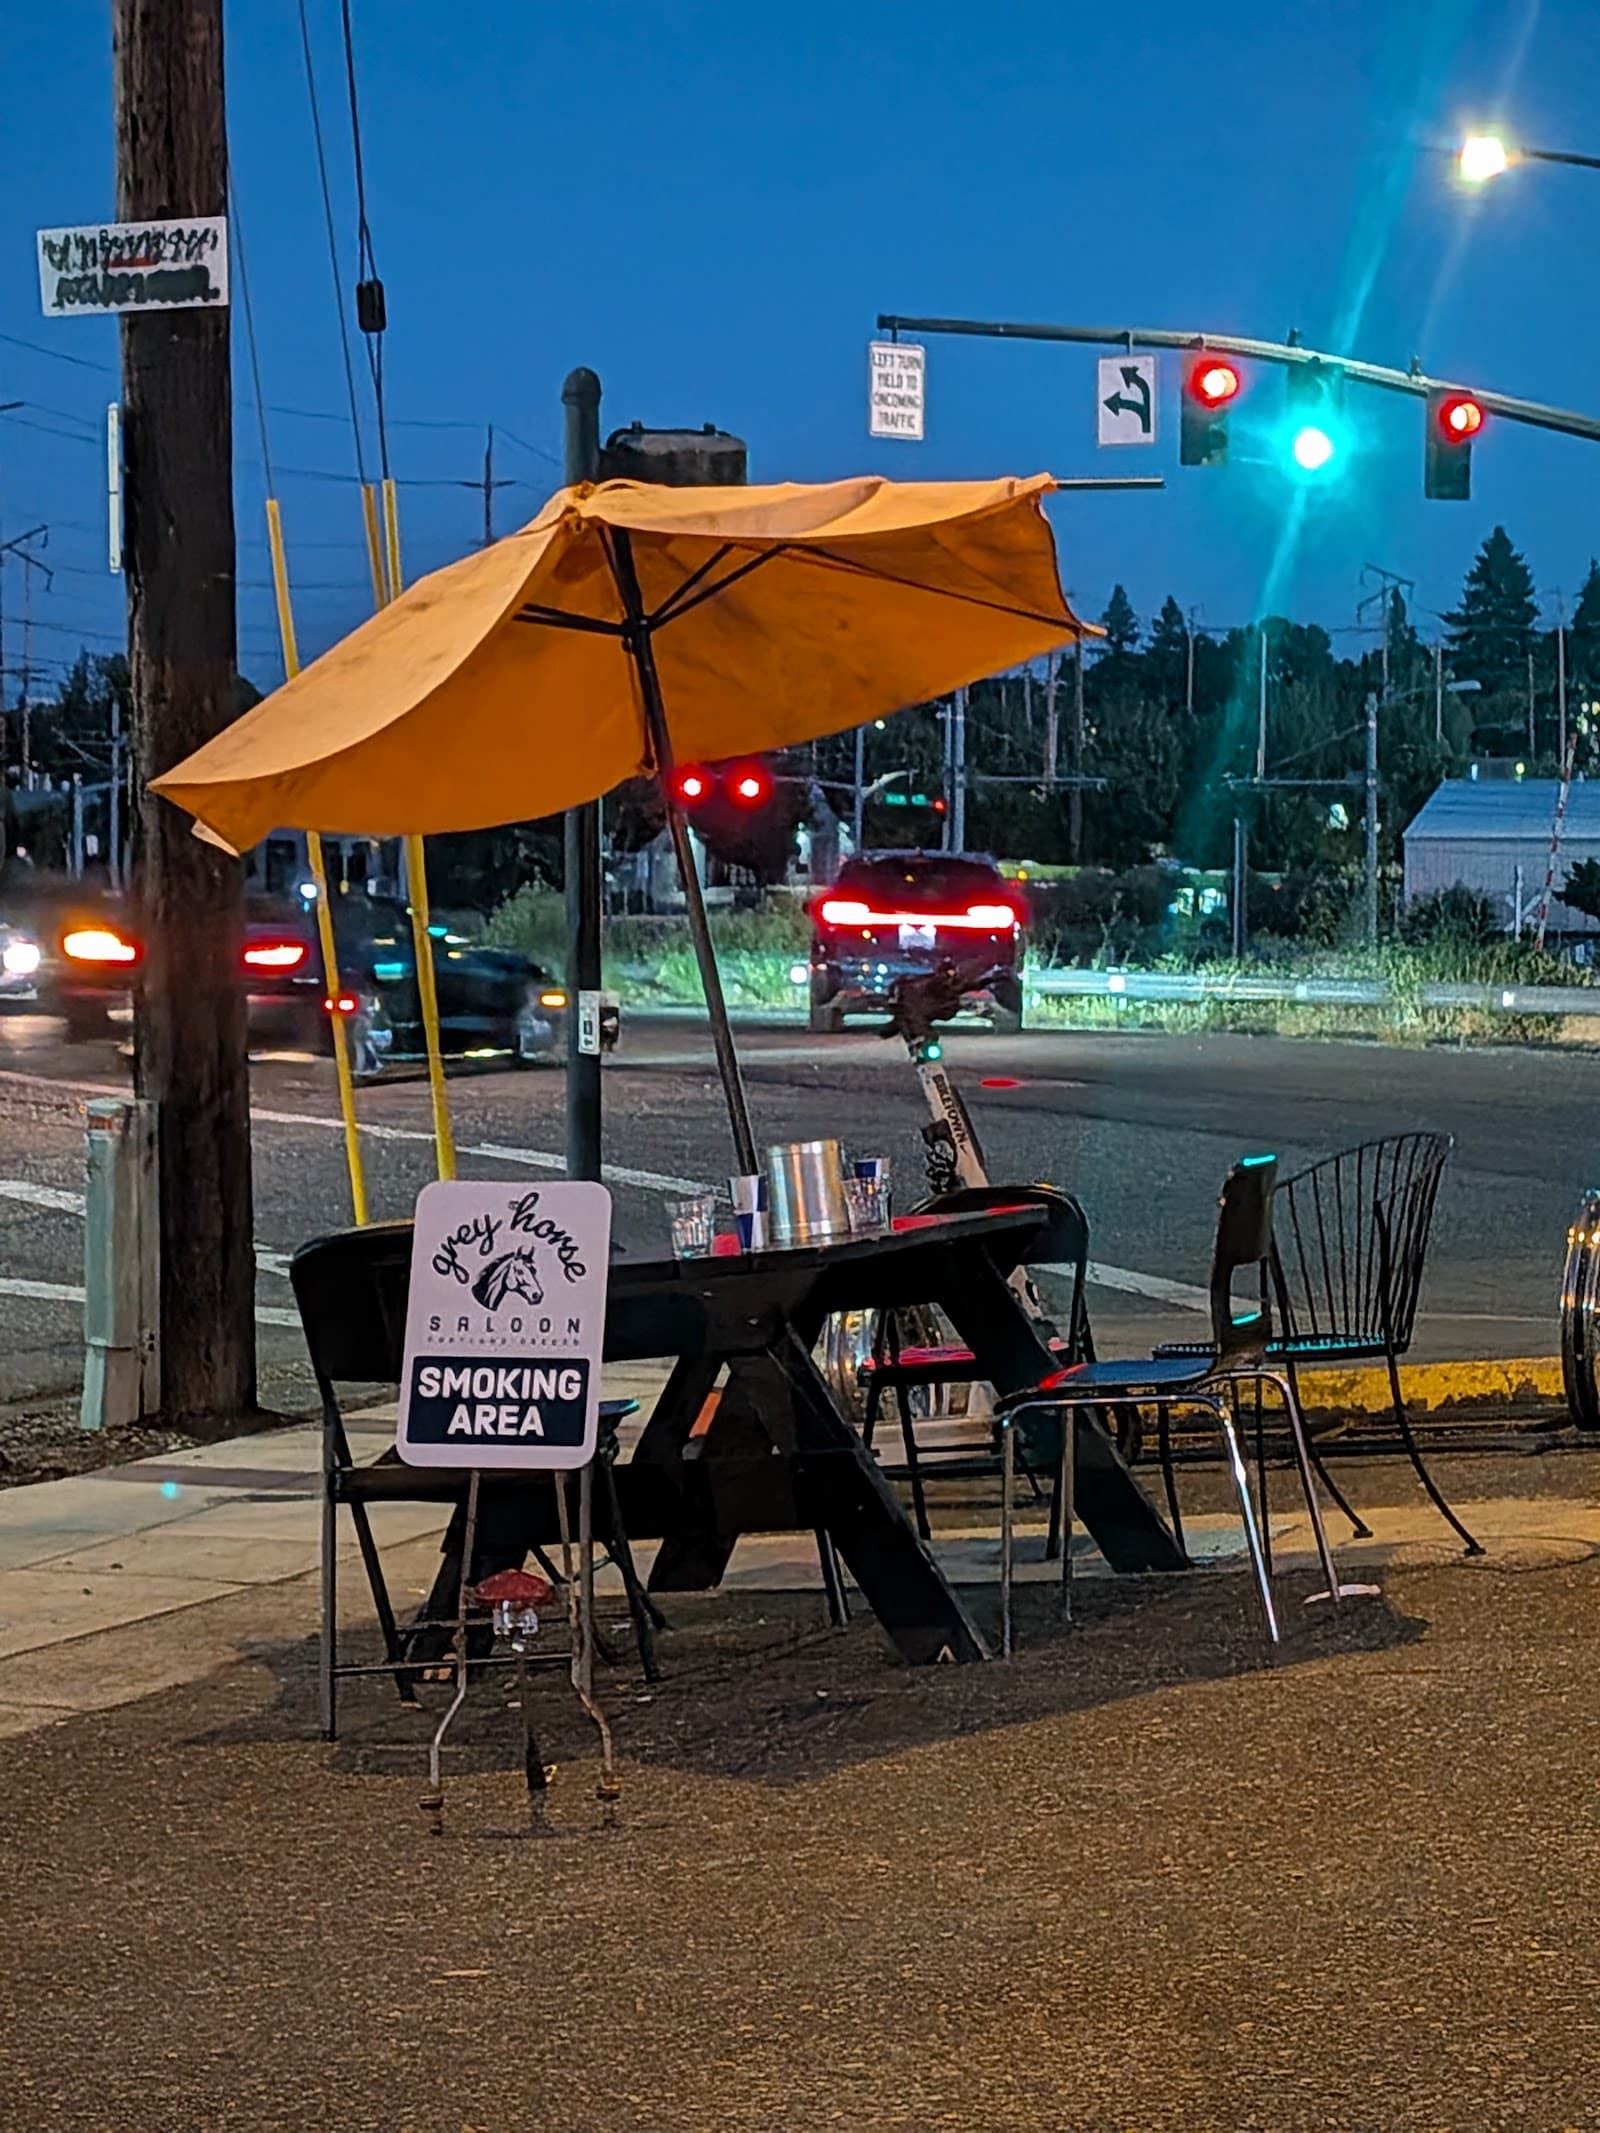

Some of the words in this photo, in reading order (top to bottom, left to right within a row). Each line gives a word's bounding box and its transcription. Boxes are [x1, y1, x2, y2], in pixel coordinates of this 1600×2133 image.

[932, 1073, 969, 1143] BIKETOWN
[432, 1214, 503, 1285] grey
[510, 1191, 587, 1284] horse
[429, 1315, 580, 1333] SALOON
[418, 1366, 582, 1401] SMOKING
[446, 1404, 545, 1437] AREA
